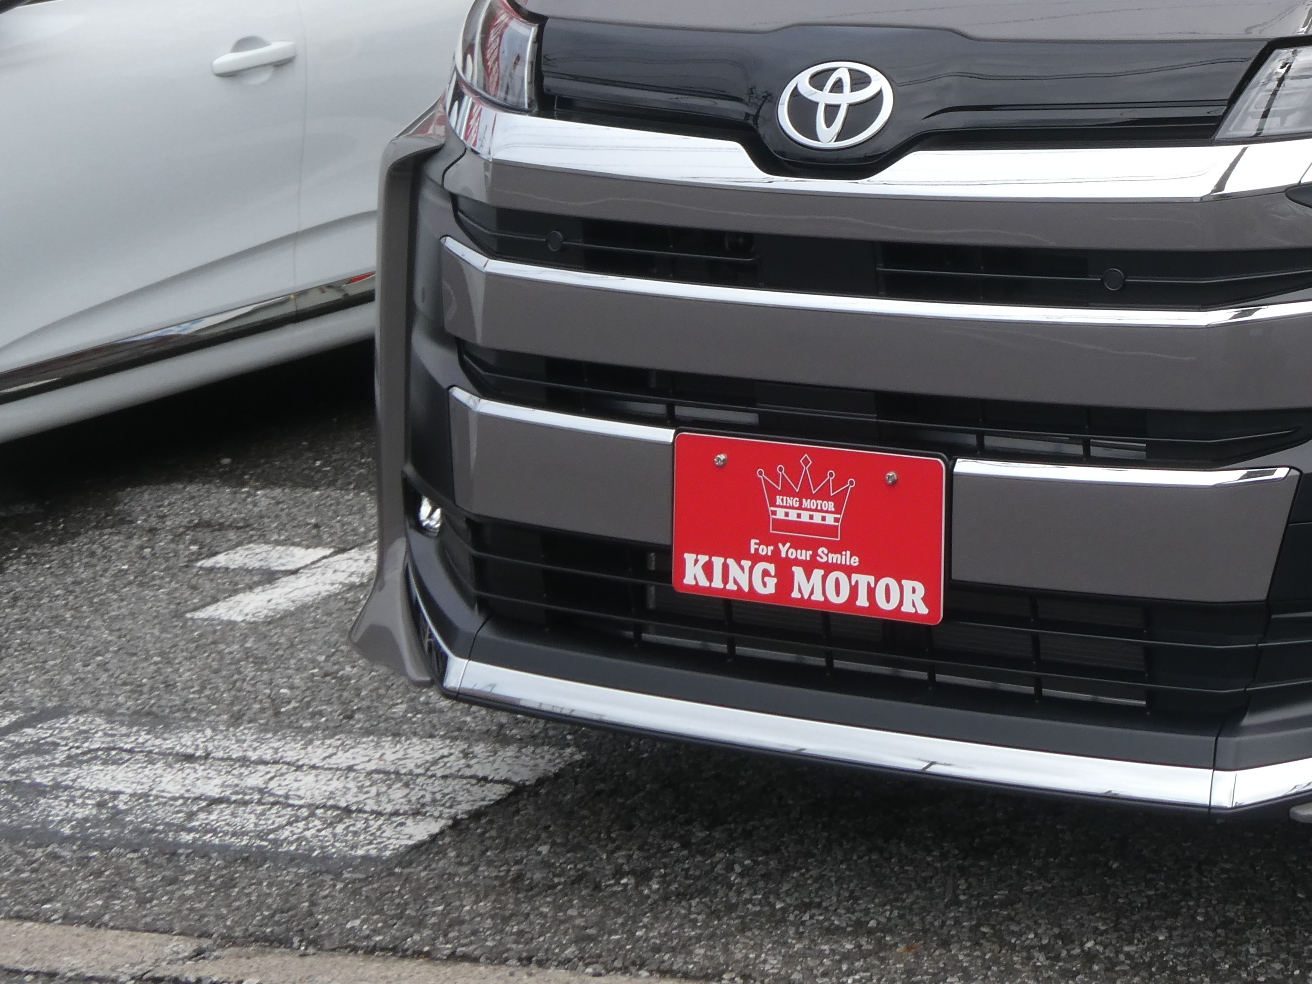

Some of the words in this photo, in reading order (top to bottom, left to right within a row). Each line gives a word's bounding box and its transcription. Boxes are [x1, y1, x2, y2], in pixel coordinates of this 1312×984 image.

[775, 495, 800, 508] KING
[802, 497, 835, 511] MOTOR
[750, 539, 773, 556] For
[778, 542, 812, 561] Your
[817, 547, 859, 567] Smile
[683, 552, 777, 595] KING
[791, 566, 929, 614] MOTOR
